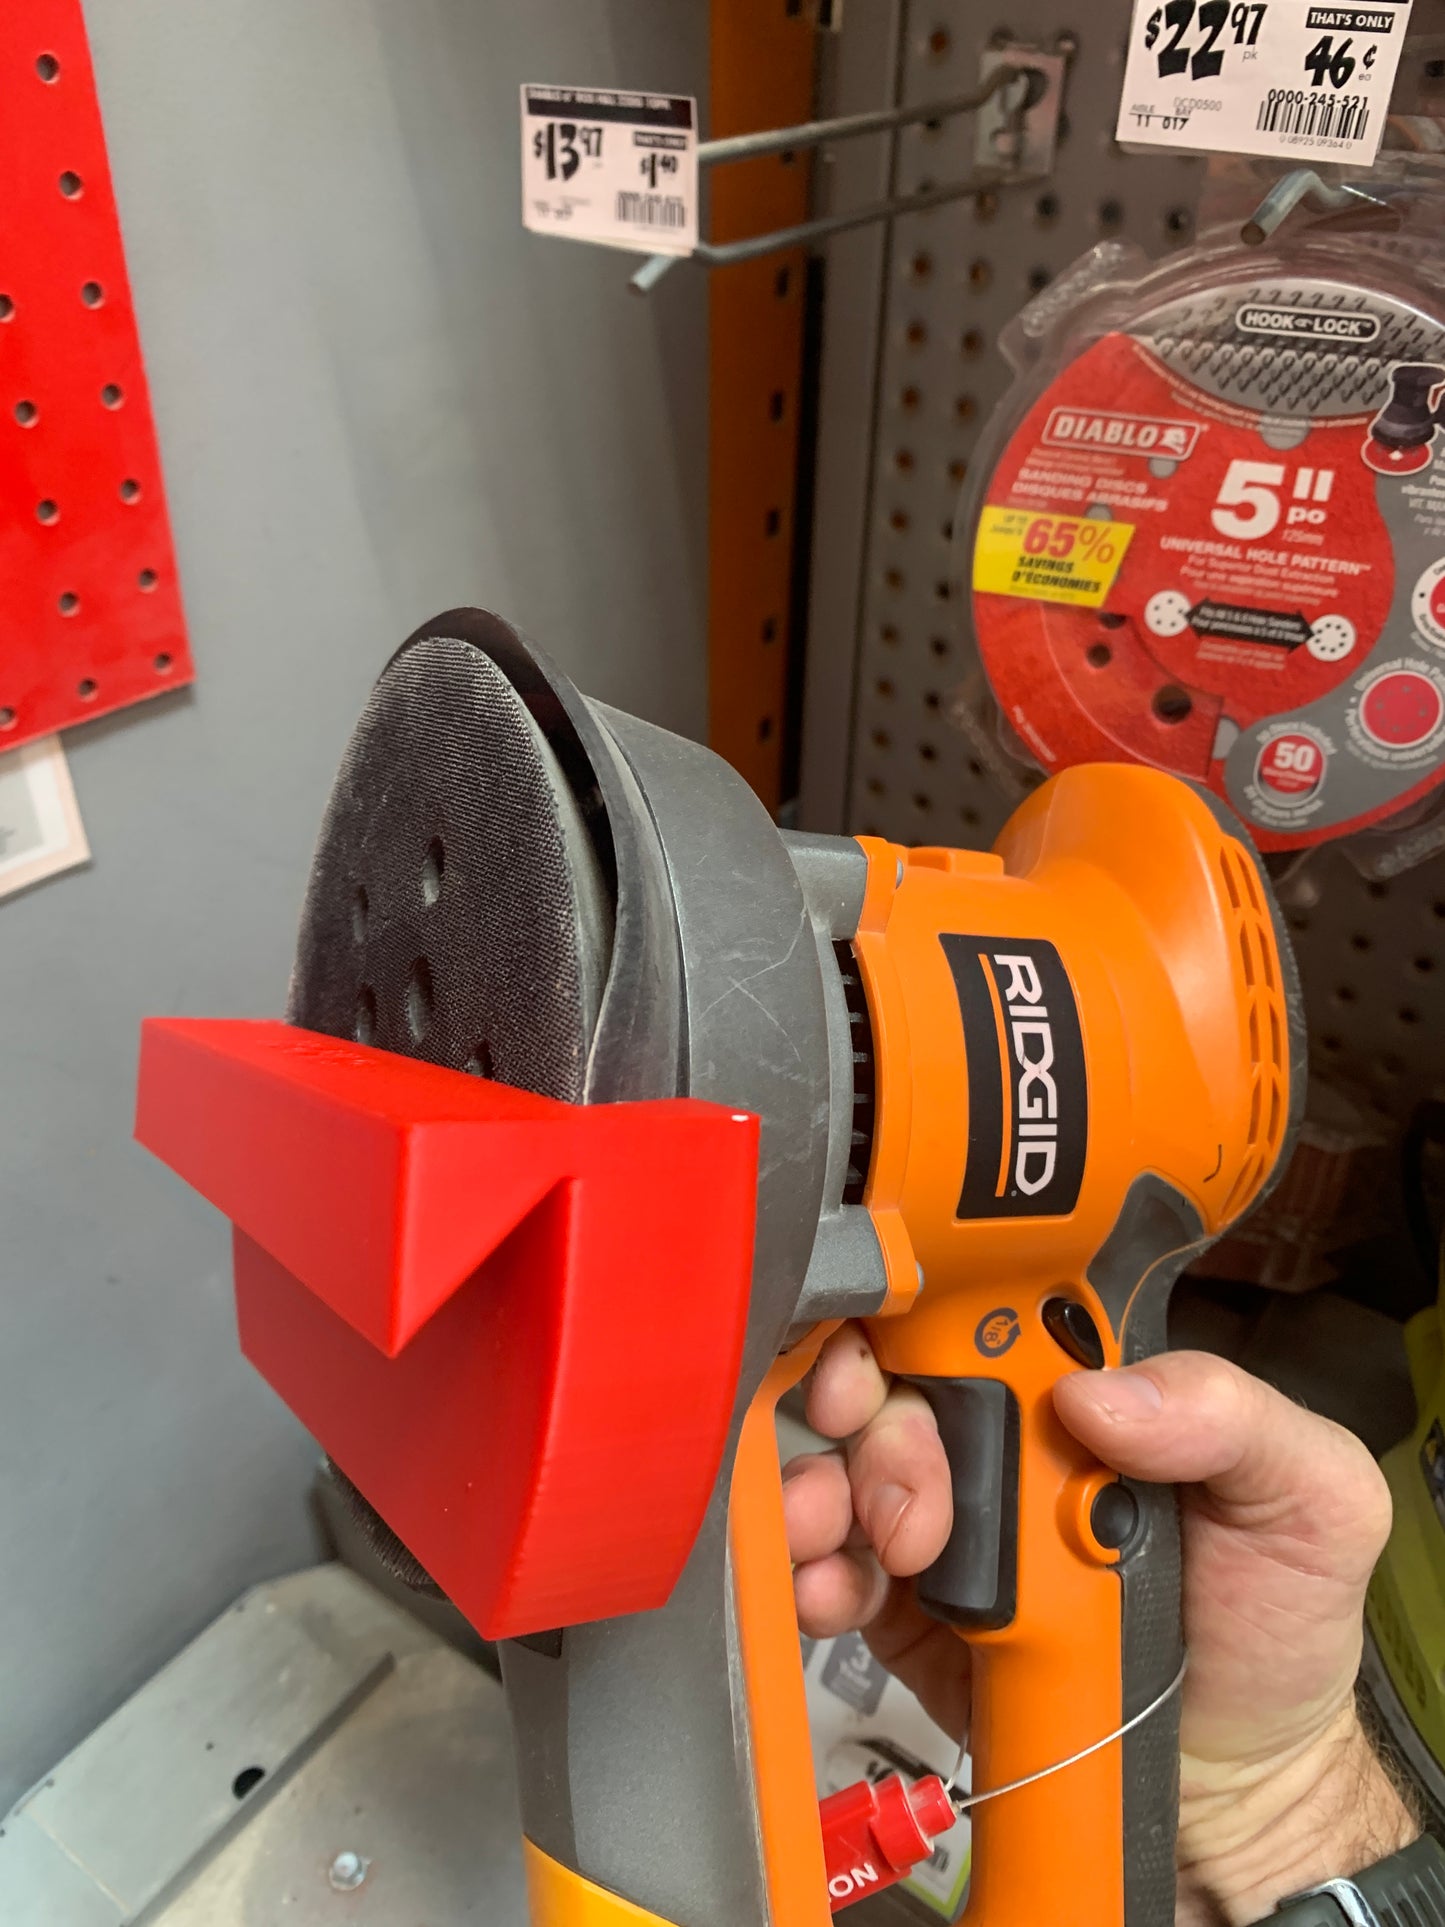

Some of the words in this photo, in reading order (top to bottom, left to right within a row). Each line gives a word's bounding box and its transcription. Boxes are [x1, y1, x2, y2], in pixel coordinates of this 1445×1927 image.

[1310, 12, 1352, 26] THAT'S
[1355, 15, 1393, 28] ONLY
[1268, 89, 1368, 110] 0000-245-521
[1162, 116, 1189, 131] 017
[1245, 311, 1295, 329] HOOK
[1053, 415, 1159, 448] DIABLO
[1286, 507, 1327, 525] po
[1023, 518, 1116, 564] 65%
[1160, 536, 1242, 560] UNIVERSAL
[1246, 548, 1289, 566] HOLE
[1017, 556, 1074, 574] SAVINGS
[1273, 742, 1316, 772] 50
[994, 955, 1057, 1195] RIDGID
